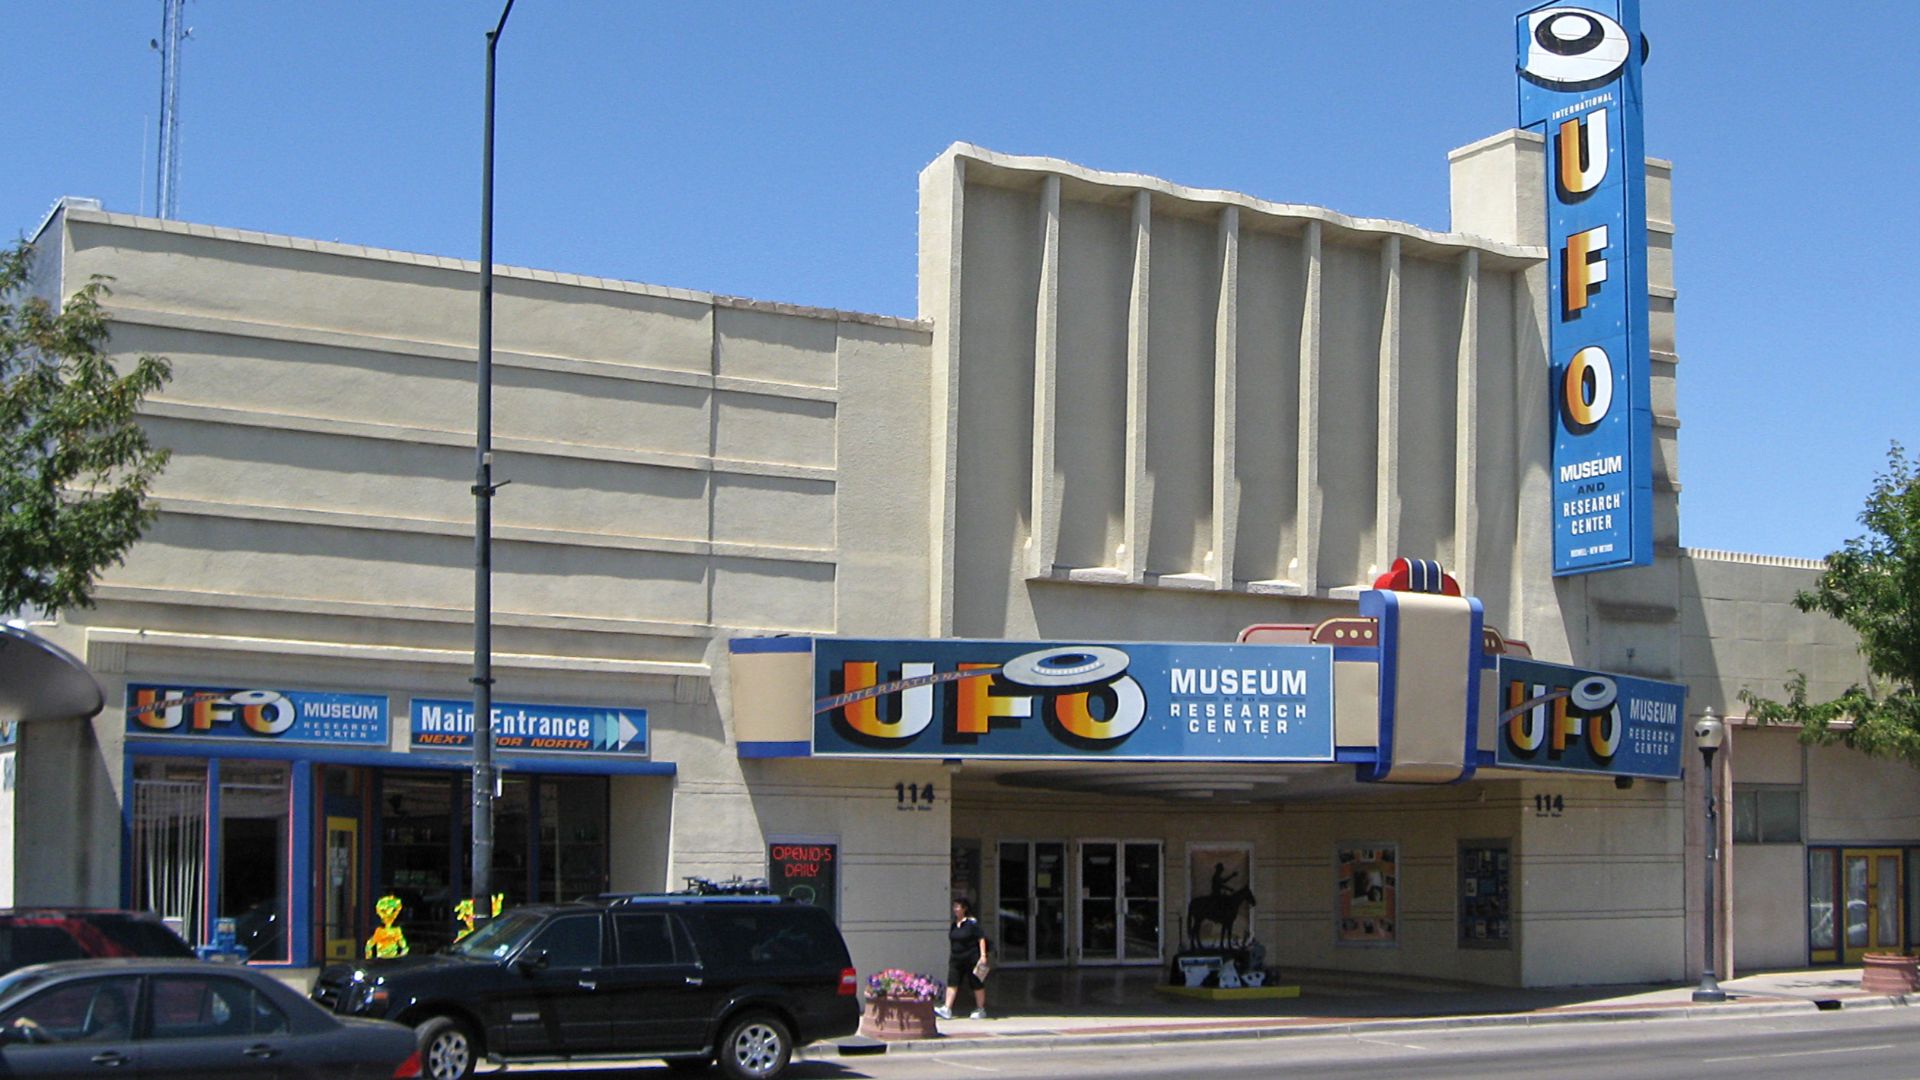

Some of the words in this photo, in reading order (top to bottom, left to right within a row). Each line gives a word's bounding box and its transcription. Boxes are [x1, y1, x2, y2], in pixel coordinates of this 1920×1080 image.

[1552, 92, 1612, 121] INTERNATIONAL
[1561, 456, 1622, 482] MUSEUM
[1578, 482, 1605, 494] AND
[1563, 494, 1620, 517] RESEARCH
[1572, 514, 1612, 535] CENTER
[834, 671, 971, 707] INTERNATIONAL
[1170, 668, 1307, 695] MUSEUM
[844, 661, 1146, 739] UFO
[1170, 703, 1307, 718] RESEARCH
[138, 690, 296, 733] UFO
[303, 702, 379, 720] MUSEUM
[1511, 682, 1622, 757] UFO
[1630, 698, 1676, 724] MUSEUM
[421, 706, 475, 733] Main
[490, 709, 590, 738] Entrance
[1189, 719, 1288, 734] CENTER
[418, 734, 467, 744] NEXT
[530, 738, 590, 749] NORTH
[1630, 728, 1675, 743] RESEARCH
[1635, 742, 1668, 755] CENTER
[894, 782, 935, 803] 114
[1534, 794, 1564, 812] 114
[772, 846, 808, 861] OPEN
[784, 863, 820, 878] DAILY
